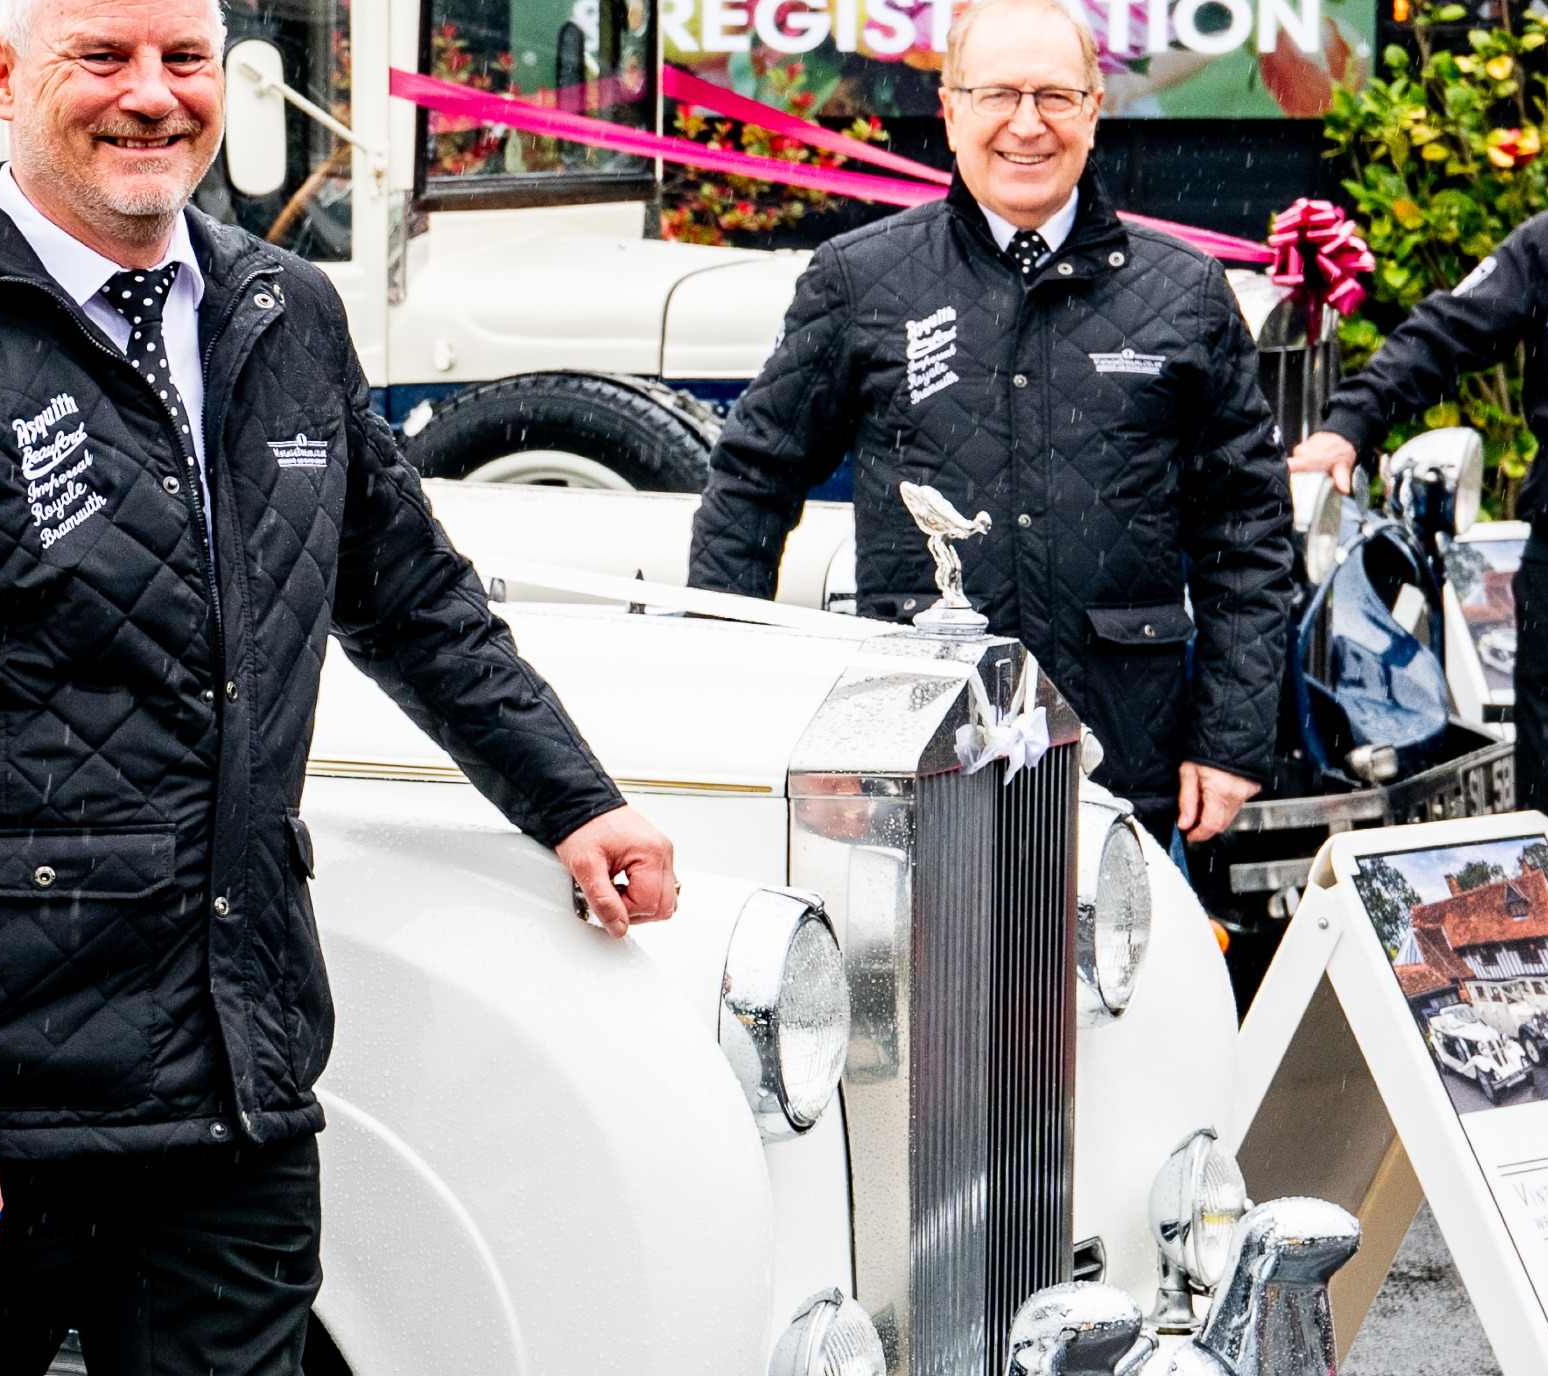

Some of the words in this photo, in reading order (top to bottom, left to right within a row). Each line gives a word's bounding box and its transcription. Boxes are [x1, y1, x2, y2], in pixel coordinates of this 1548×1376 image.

[12, 393, 79, 448] Asquith
[22, 422, 88, 477] Beauford
[28, 449, 93, 503] Imperial
[31, 480, 87, 526] Royale
